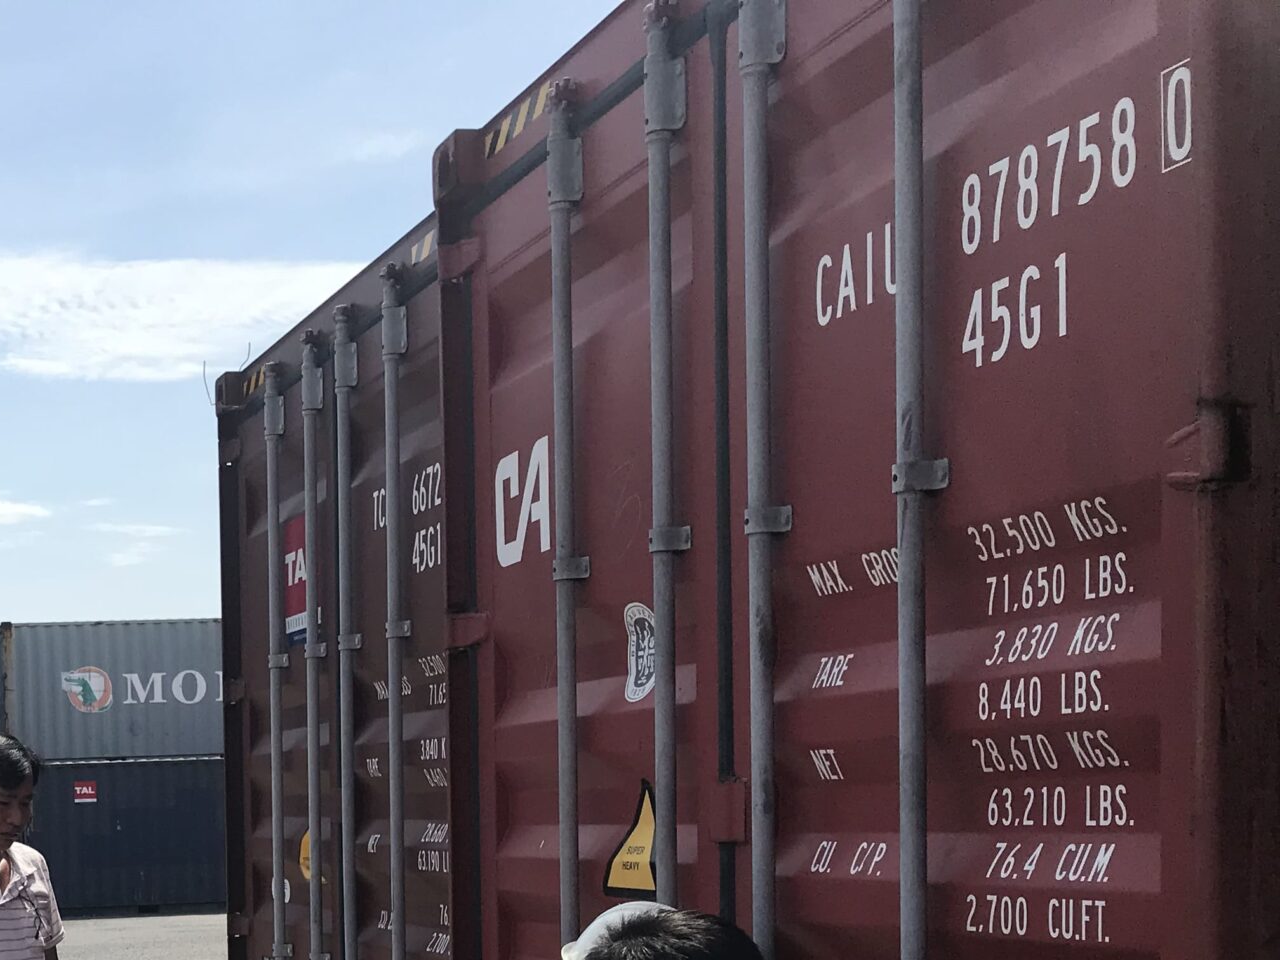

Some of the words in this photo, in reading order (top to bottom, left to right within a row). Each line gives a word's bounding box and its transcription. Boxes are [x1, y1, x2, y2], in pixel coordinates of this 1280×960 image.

[816, 222, 897, 326] CAIU
[961, 97, 1136, 255] 878758
[1167, 66, 1192, 161] 0
[962, 252, 1068, 368] 45G1
[373, 488, 386, 531] TC
[285, 547, 307, 587] TA
[412, 522, 441, 573] 45G1
[807, 560, 853, 597] MAX.
[861, 547, 899, 587] GRO
[1064, 496, 1128, 542] KGS.
[1084, 552, 1134, 600] LBS.
[812, 653, 854, 689] TARE
[1067, 613, 1120, 656] KGS.
[978, 676, 1041, 720] 8,440
[1061, 669, 1109, 714] LBS.
[809, 749, 844, 780] NET
[1066, 729, 1129, 769] KGS.
[74, 786, 95, 794] TAL
[1085, 784, 1135, 827] LBS.
[622, 860, 640, 871] HEAVY
[811, 840, 838, 873] CU.
[986, 842, 1044, 880] 76.4
[1055, 843, 1116, 883] CU.M.
[966, 894, 1028, 935] 2,700
[1048, 898, 1110, 943] CU.FT.
